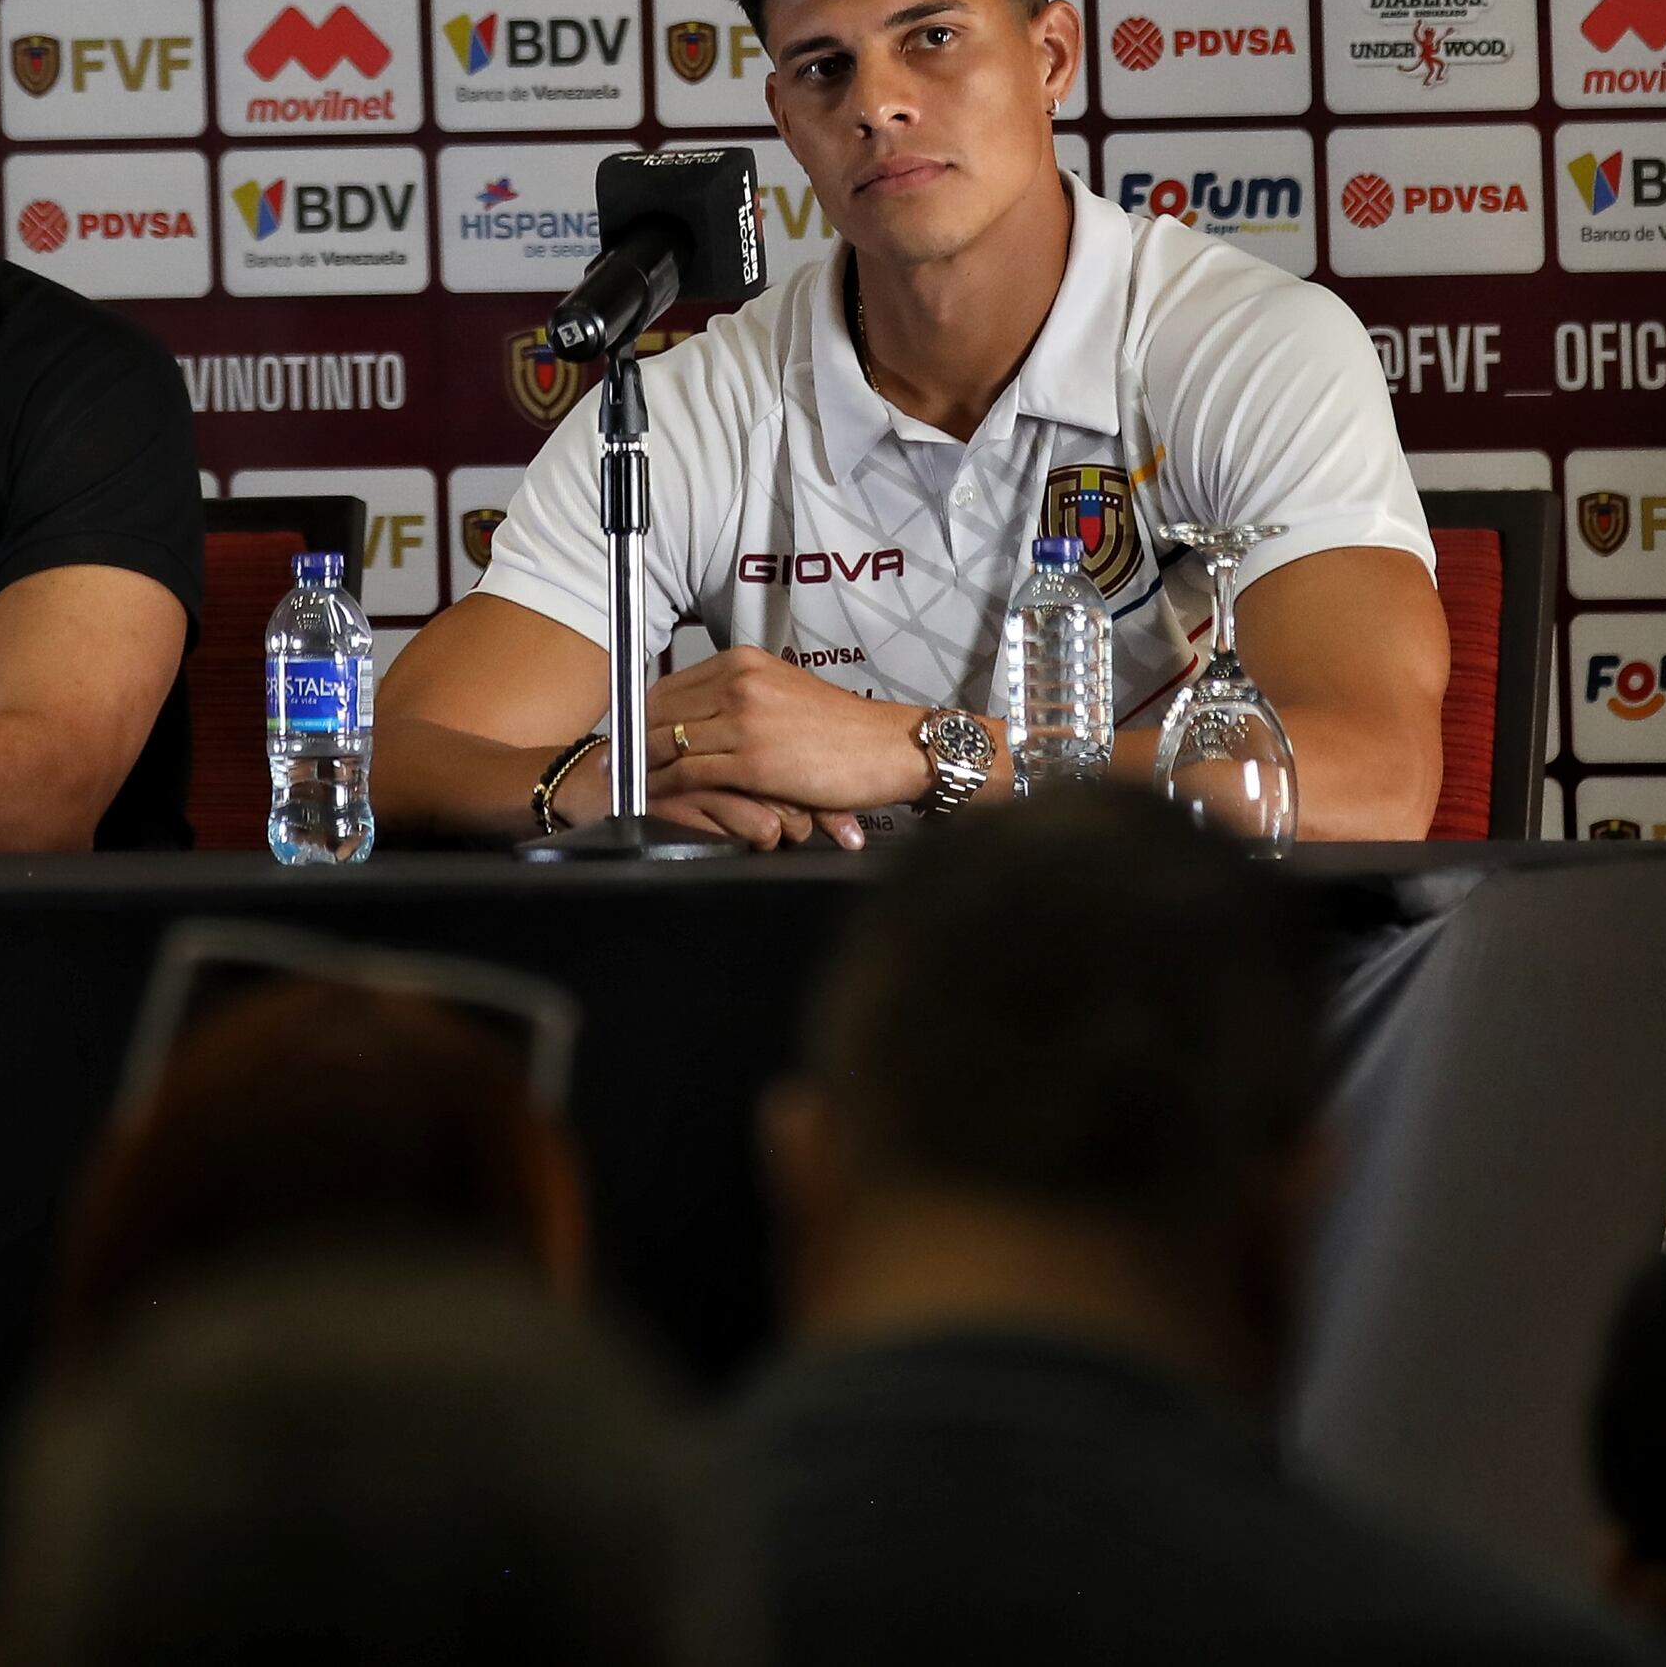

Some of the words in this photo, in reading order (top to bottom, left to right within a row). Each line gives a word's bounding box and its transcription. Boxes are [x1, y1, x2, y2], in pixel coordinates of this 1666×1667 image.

[507, 17, 629, 67] BDV
[1173, 27, 1295, 57] PDVSA
[71, 36, 193, 92] FVF
[246, 90, 395, 122] movilnet
[294, 184, 415, 233] BDV
[1121, 173, 1303, 226] Forum
[1404, 184, 1528, 214] PDVSA
[78, 211, 196, 239] PDVSA
[1580, 224, 1633, 243] Banco
[1635, 224, 1655, 243] de
[561, 326, 576, 345] 3
[180, 352, 406, 413] VINOTINTO
[363, 514, 426, 570] VF
[800, 647, 867, 668] PDVSA
[266, 677, 331, 697] CRSTAL
